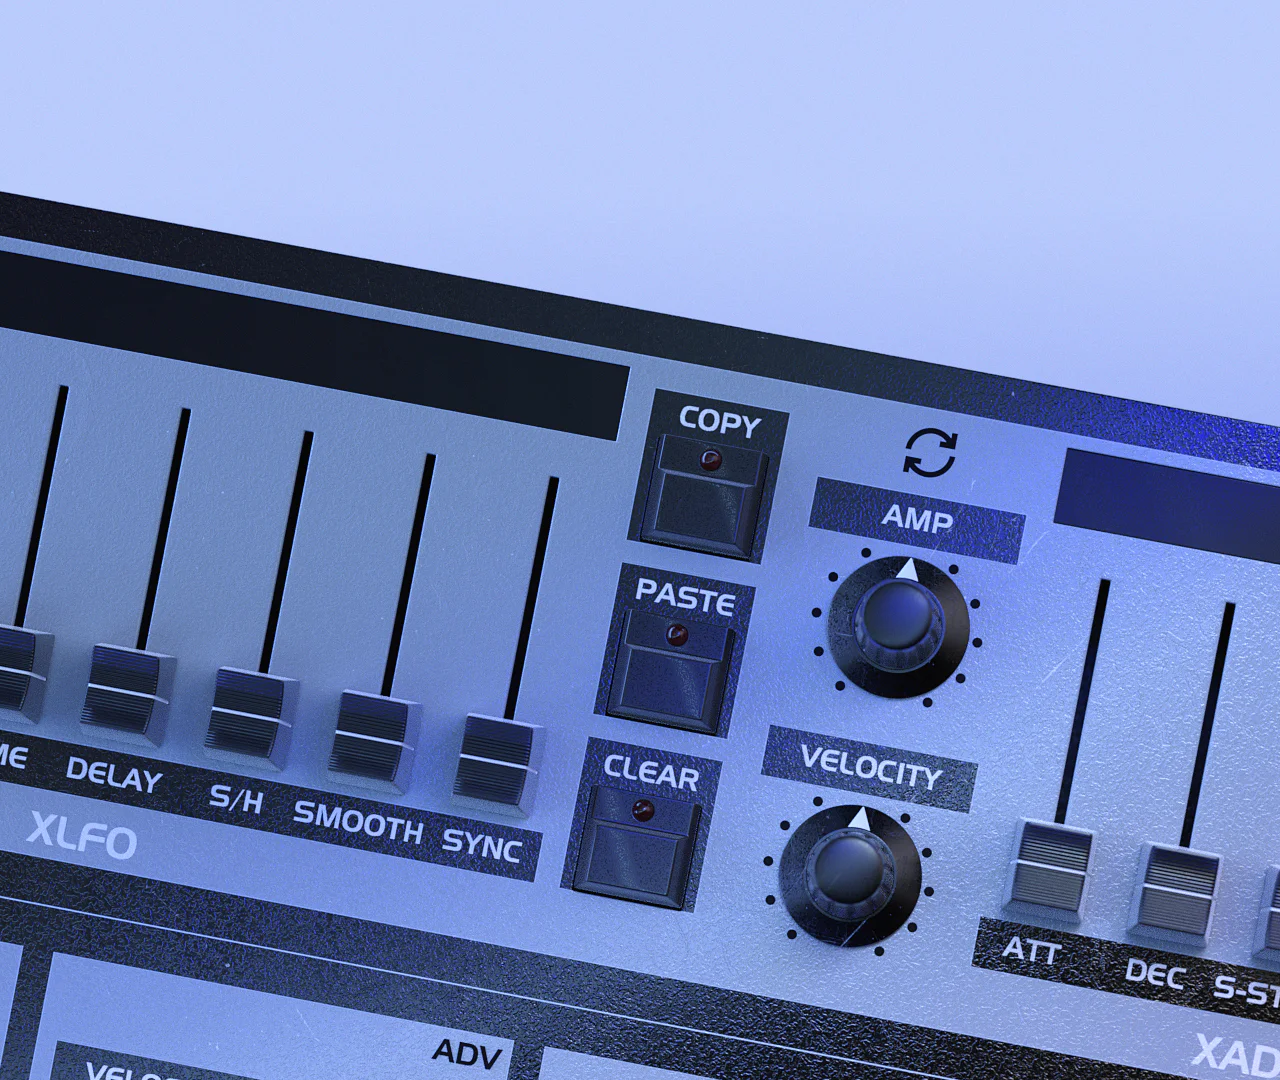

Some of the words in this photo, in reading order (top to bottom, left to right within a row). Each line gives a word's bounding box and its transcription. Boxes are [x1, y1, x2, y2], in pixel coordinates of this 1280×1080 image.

[679, 405, 762, 439] COPY
[880, 503, 954, 534] AMP
[635, 577, 736, 617] PASTE
[66, 756, 164, 794] DELAY
[603, 754, 700, 792] CLEAR
[800, 743, 944, 791] VELOCITY
[209, 784, 264, 815] S/H
[25, 810, 138, 860] XLFO
[293, 800, 425, 845] SMOOTH
[441, 828, 523, 864] SYNC
[1001, 935, 1063, 966] ATT
[1125, 957, 1188, 991] DEC
[431, 1038, 503, 1071] ADV
